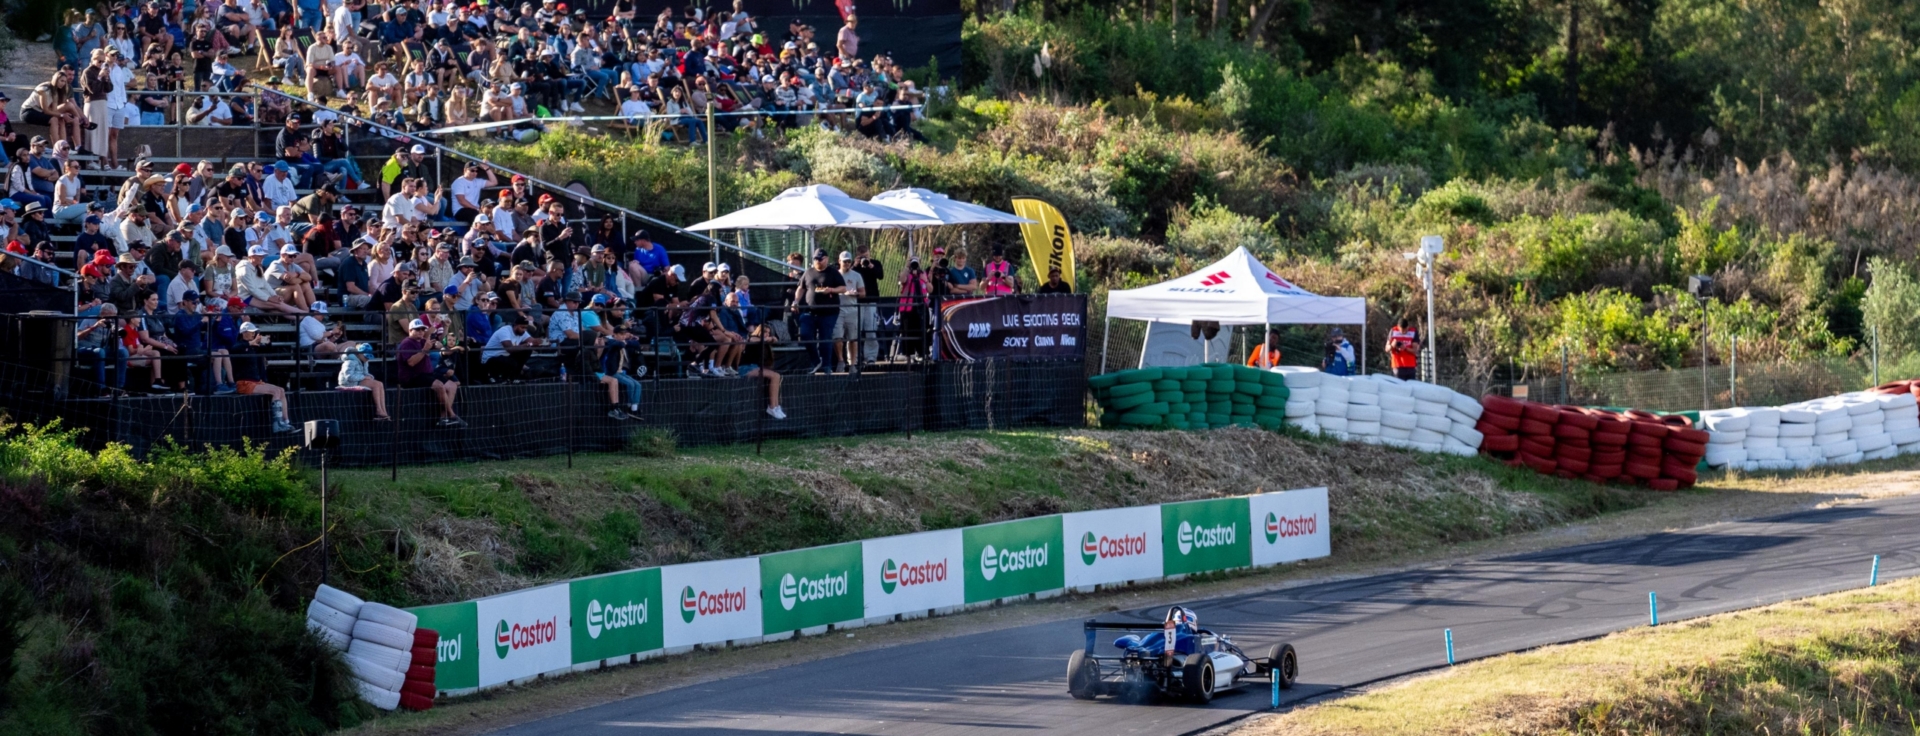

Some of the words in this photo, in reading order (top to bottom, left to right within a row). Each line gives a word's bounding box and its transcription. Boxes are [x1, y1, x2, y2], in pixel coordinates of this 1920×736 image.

[1002, 314, 1020, 327] LIVE
[1061, 312, 1081, 326] DECK
[1002, 336, 1029, 347] SONY
[1194, 522, 1236, 548] Castrol
[1279, 513, 1317, 538] Castrol
[1000, 542, 1048, 573] Castrol
[1099, 532, 1146, 559] Castrol
[798, 570, 848, 602] Castrol
[899, 558, 947, 587] Castrol
[604, 597, 648, 630] Castrol
[698, 587, 746, 616] Castrol
[511, 615, 556, 650] Castrol
[1167, 631, 1173, 645] 3
[437, 633, 462, 663] trol
